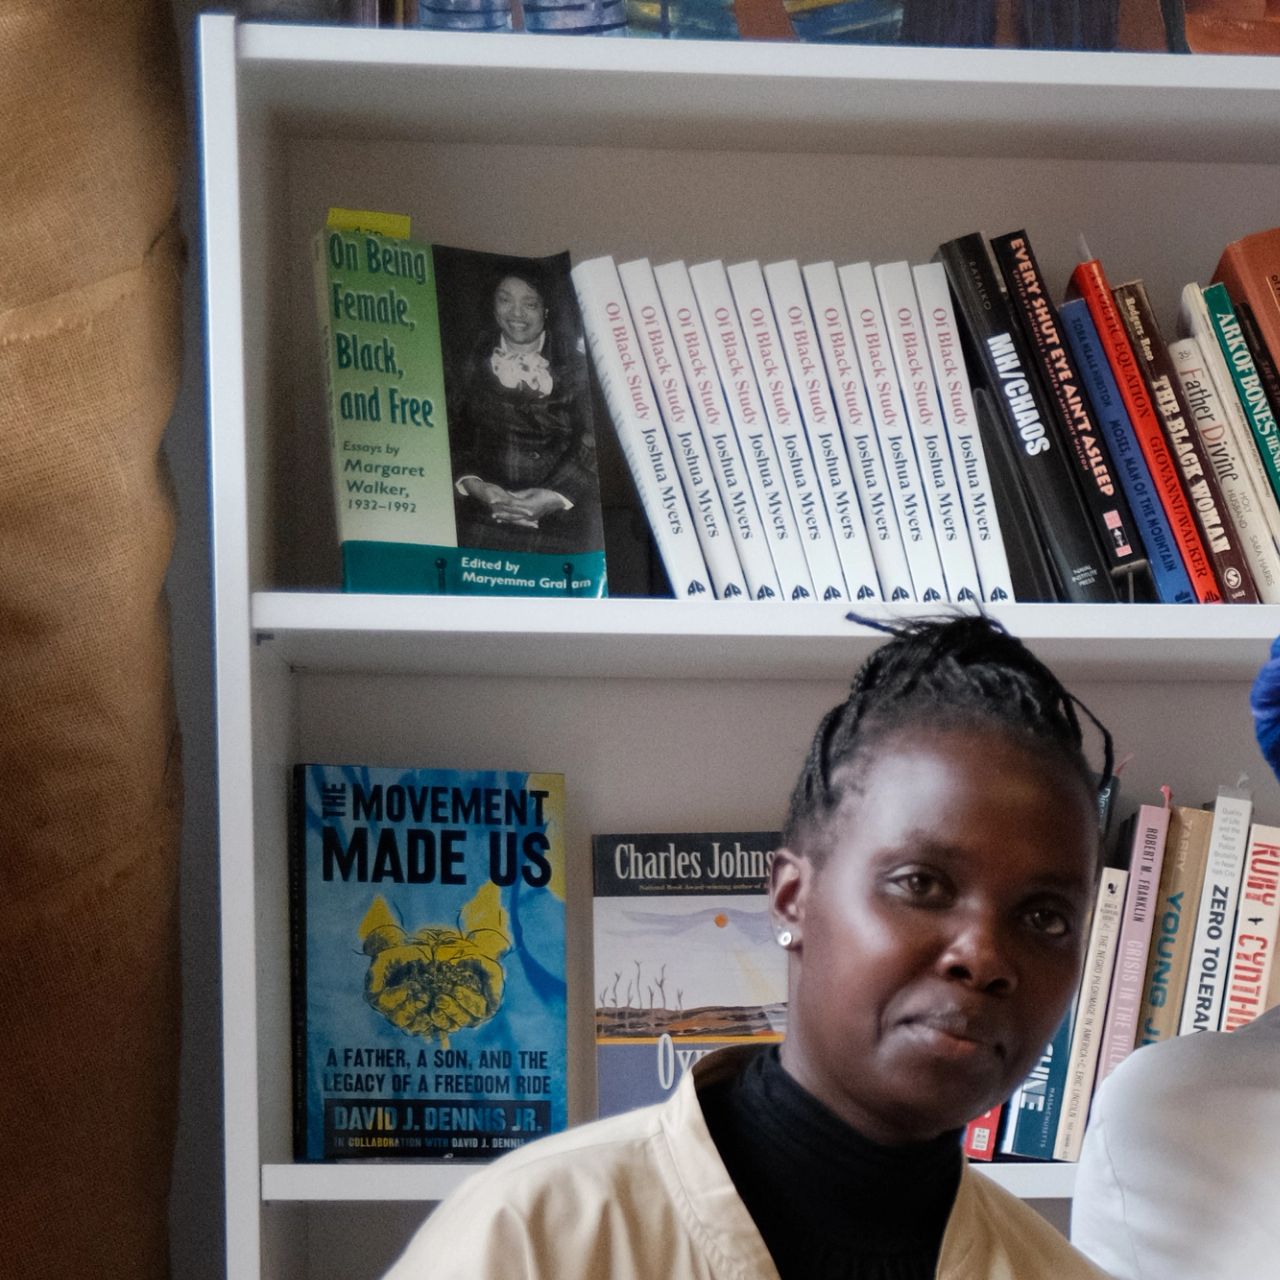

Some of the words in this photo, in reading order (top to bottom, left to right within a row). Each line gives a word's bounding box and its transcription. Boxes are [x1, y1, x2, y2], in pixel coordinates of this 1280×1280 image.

[329, 232, 359, 271] On
[366, 236, 426, 285] Being
[1008, 236, 1042, 296] EVERY
[333, 282, 416, 331] Female,
[604, 300, 622, 324] Of
[639, 304, 657, 326] Of
[676, 306, 693, 328] Of
[713, 306, 730, 328] Of
[748, 306, 766, 328] Of
[786, 304, 804, 328] Of
[823, 306, 840, 328] Of
[859, 307, 876, 330] Of
[896, 306, 913, 330] Of
[932, 306, 948, 330] Of
[1030, 296, 1060, 346] SHUT
[1122, 296, 1156, 362] Rodgers-Rose
[1215, 307, 1248, 354] ARK
[335, 332, 404, 379] Black,
[611, 324, 636, 372] Black
[646, 328, 672, 376] Black
[682, 330, 708, 378] Black
[720, 330, 744, 377] Black
[754, 330, 780, 378] Black
[792, 328, 816, 376] Black
[828, 330, 852, 378] Black
[864, 332, 888, 379] Black
[902, 330, 924, 378] Black
[936, 330, 959, 378] Black
[1048, 346, 1073, 381] EYE
[1230, 348, 1254, 372] OF
[339, 385, 381, 422] and
[388, 387, 434, 428] Free
[624, 373, 650, 421] Study
[660, 376, 686, 424] Study
[696, 378, 722, 426] Study
[732, 378, 758, 426] Study
[767, 378, 792, 426] Study
[804, 378, 828, 426] Study
[840, 380, 864, 427] Study
[875, 380, 898, 428] Study
[910, 380, 934, 428] Study
[946, 380, 969, 429] Study
[986, 332, 1050, 456] MH/CHAOS
[1060, 382, 1092, 432] AIN'T
[1150, 374, 1180, 416] THE
[1238, 372, 1277, 436] BONES
[343, 440, 382, 456] Essays
[385, 443, 400, 457] by
[1106, 418, 1133, 458] MOSES,
[1164, 415, 1204, 480] BLACK
[1177, 366, 1218, 424] Father
[1199, 422, 1241, 486] Divine
[343, 458, 425, 478] Margaret
[640, 426, 669, 483] Joshua
[676, 430, 704, 486] Joshua
[711, 432, 739, 488] Joshua
[748, 432, 774, 489] Joshua
[782, 432, 808, 489] Joshua
[818, 432, 843, 488] Joshua
[853, 434, 879, 490] Joshua
[888, 435, 912, 491] Joshua
[923, 434, 947, 490] Joshua
[958, 434, 981, 490] Joshua
[1080, 433, 1116, 497] ASLEEP
[1111, 340, 1152, 419] EQUATION
[1146, 434, 1212, 578] GIOVANNI/WALKER
[1122, 455, 1143, 482] MAN
[345, 479, 410, 498] Walker,
[659, 484, 684, 535] Myers
[1132, 480, 1150, 497] OF
[1138, 496, 1157, 518] THE
[1224, 487, 1248, 530] HUSBAND
[1238, 490, 1253, 513] HOLY
[695, 488, 719, 538] Myers
[729, 490, 753, 540] Myers
[764, 490, 788, 541] Myers
[798, 490, 821, 542] Myers
[832, 490, 856, 541] Myers
[868, 491, 890, 542] Myers
[902, 493, 924, 544] Myers
[936, 493, 958, 544] Myers
[970, 493, 992, 544] Myers
[1188, 478, 1232, 554] WOMAN
[461, 557, 502, 570] Edited
[505, 561, 520, 574] by
[1144, 516, 1180, 572] MOUNTAIN
[1247, 534, 1263, 558] SARA
[1256, 556, 1274, 588] HARRIS
[462, 572, 536, 587] Maryemma
[321, 782, 346, 820] THE
[352, 783, 550, 827] MOVEMENT
[322, 826, 467, 885] MADE
[489, 831, 552, 888] US
[615, 842, 702, 880] Charles
[1141, 826, 1158, 862] ROBERT
[1139, 864, 1152, 876] M.
[1132, 878, 1150, 922] FRANKLIN
[1206, 884, 1229, 940] ZERO
[1120, 938, 1144, 982] CRISIS
[1146, 888, 1184, 1008] YOUNG
[1118, 986, 1136, 1000] IN
[1224, 932, 1268, 1030] CYNTHI
[1114, 1005, 1134, 1028] THE
[326, 1048, 338, 1067] A
[343, 1048, 411, 1070] FATHER,
[416, 1049, 427, 1068] A
[433, 1049, 473, 1071] SON,
[479, 1050, 512, 1069] AND
[518, 1051, 547, 1070] THE
[323, 1073, 386, 1093] LEGACY
[392, 1073, 412, 1093] OF
[417, 1074, 429, 1093] A
[434, 1074, 510, 1094] FREEDOM
[516, 1075, 551, 1095] RIDE
[334, 1106, 397, 1131] DAVID
[402, 1106, 420, 1131] J.
[424, 1107, 506, 1132] DENNIS
[511, 1107, 543, 1132] JR.
